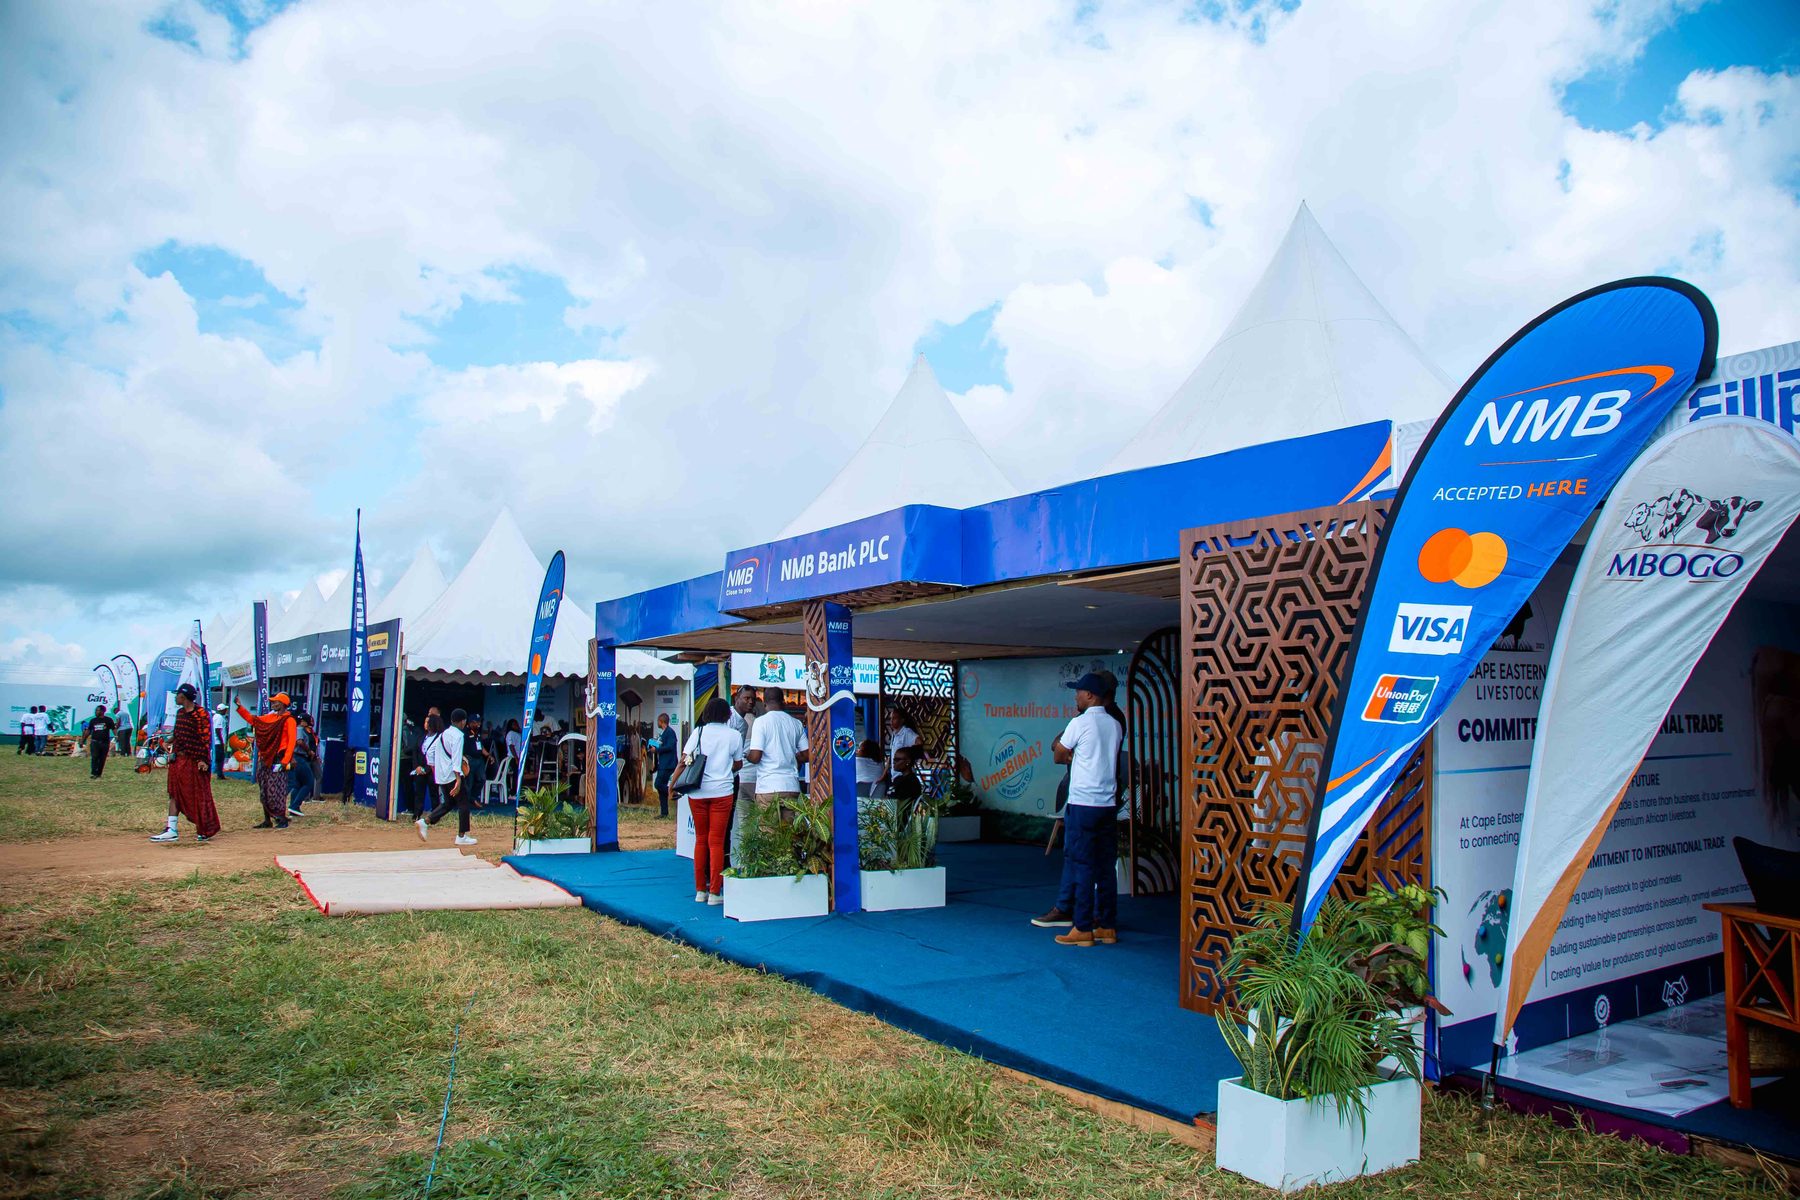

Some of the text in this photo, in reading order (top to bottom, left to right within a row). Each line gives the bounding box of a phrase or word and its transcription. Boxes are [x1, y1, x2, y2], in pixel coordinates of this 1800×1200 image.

[1464, 389, 1632, 446] NMB
[1432, 478, 1588, 500] ACCEPTED HERE
[780, 535, 890, 582] NMB Bank PLC
[1606, 553, 1744, 578] MBOGO
[726, 566, 754, 587] NMB
[726, 588, 738, 596] Close
[744, 587, 752, 595] you
[538, 598, 556, 620] NMB
[828, 622, 848, 630] NMB
[1398, 614, 1464, 642] VISA
[1500, 664, 1546, 680] EASTERN
[272, 678, 308, 697] BUILT
[1376, 686, 1428, 704] UnionPay
[1476, 686, 1539, 700] LIVESTOCK
[984, 702, 1058, 718] Tunakulinda
[1685, 714, 1724, 733] TRADE
[982, 741, 1042, 792] UmeBIMA?
[995, 746, 1014, 766] NMB
[1632, 773, 1660, 788] FUTURE
[1633, 798, 1638, 808] is
[1640, 797, 1658, 808] more
[1658, 794, 1673, 806] than
[1711, 791, 1720, 800] our
[1460, 816, 1470, 829] At
[1472, 816, 1495, 830] Cape
[1614, 815, 1644, 832] premium
[1646, 812, 1668, 824] African
[1669, 809, 1696, 822] Livestock
[1460, 831, 1520, 849] to connecting
[1632, 848, 1642, 861] TO
[1644, 840, 1702, 860] INTERNATIONAL
[1702, 836, 1725, 850] TRADE
[1581, 888, 1603, 904] quality
[1604, 883, 1631, 896] livestock
[1632, 882, 1639, 890] to
[1640, 876, 1658, 892] global
[1659, 874, 1682, 884] markets
[1585, 912, 1596, 924] the
[1597, 909, 1621, 923] highest
[1622, 902, 1652, 915] standards
[1653, 900, 1659, 910] in
[1692, 890, 1710, 900] animal
[1550, 915, 1697, 957] Building sustainable partnerships across borders
[1551, 932, 1718, 981] Creating Value for producers and global customers alike
